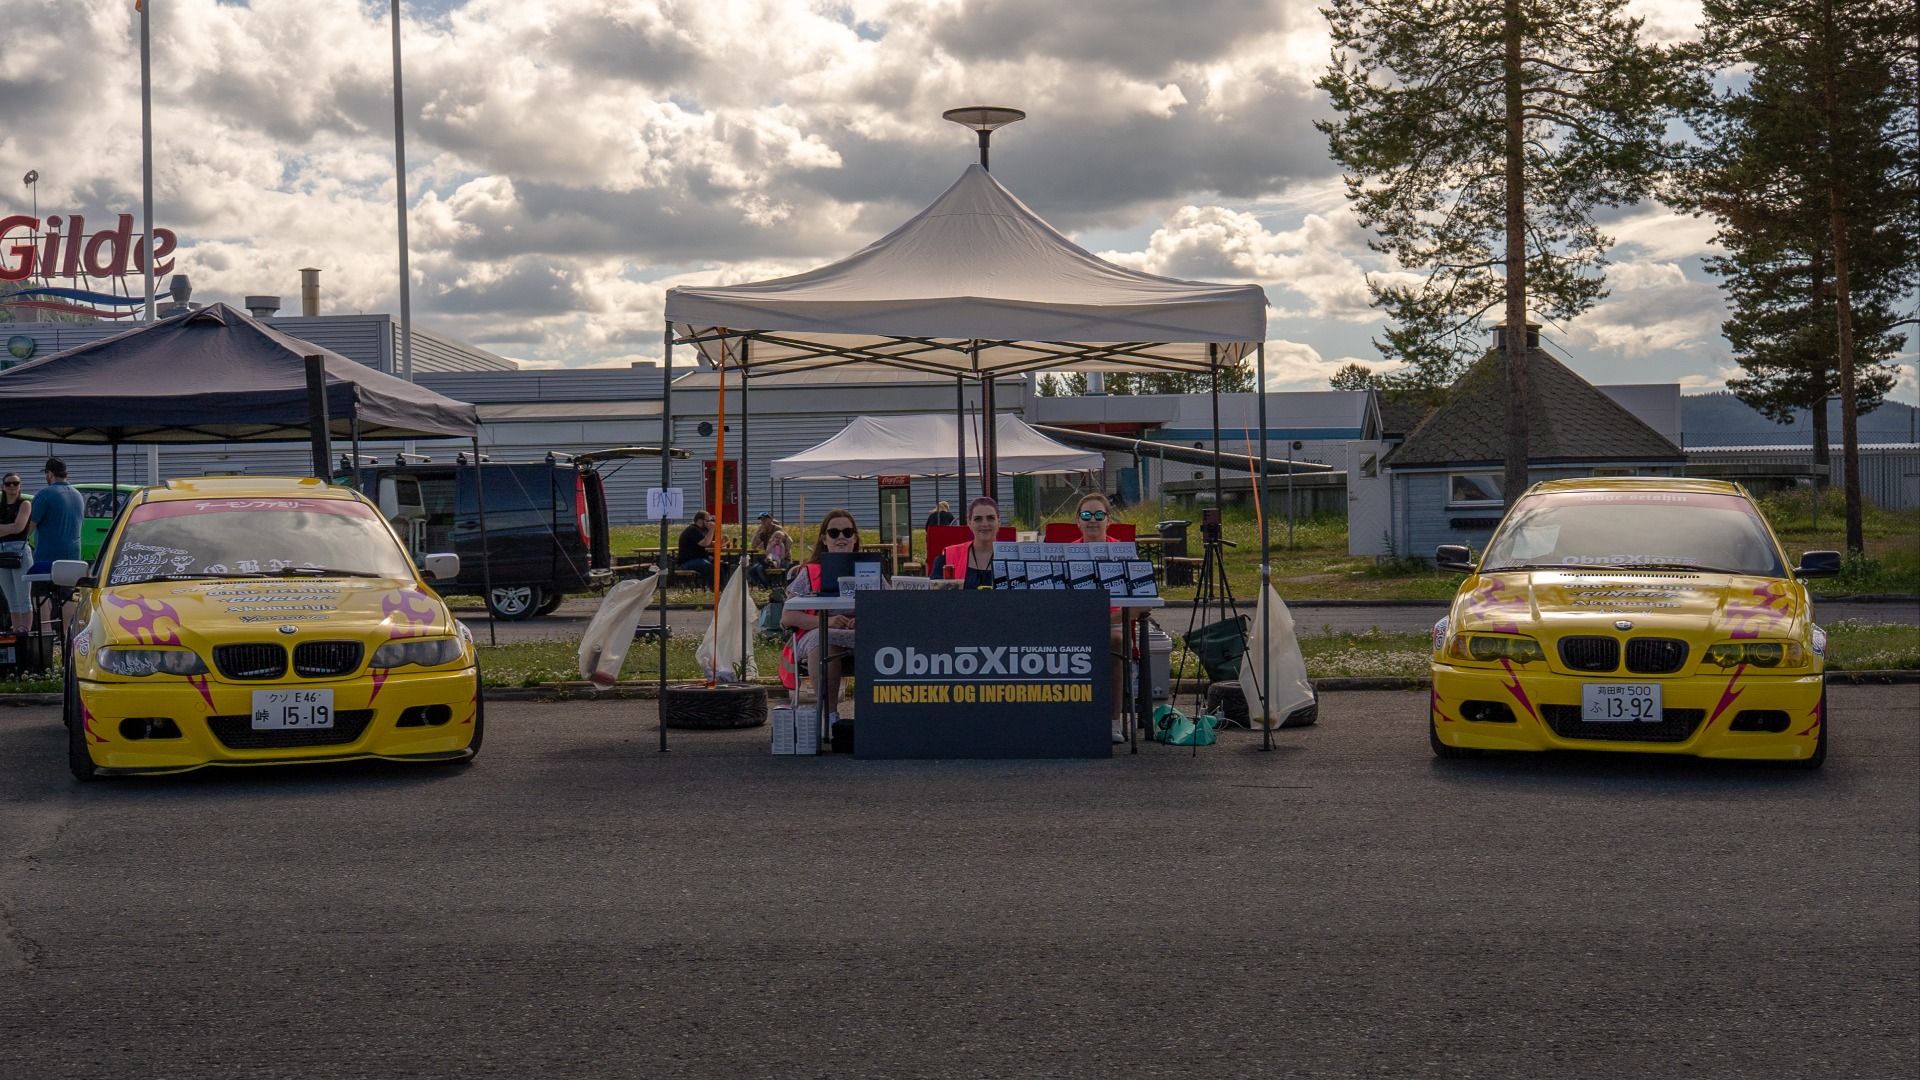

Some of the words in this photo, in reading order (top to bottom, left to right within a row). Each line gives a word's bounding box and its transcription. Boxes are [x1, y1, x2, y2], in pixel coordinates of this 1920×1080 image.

[0, 213, 178, 282] Gilde
[881, 476, 906, 485] Coca-Cola
[652, 491, 681, 508] PANT
[269, 693, 289, 704] クソ
[873, 685, 950, 704] INNSJEKK
[953, 685, 976, 703] OG
[979, 684, 1093, 703] INFORMASJON
[1627, 686, 1652, 696] 500
[283, 705, 329, 726] 15-19
[1590, 701, 1603, 714] ふ
[1607, 697, 1655, 718] 13-92
